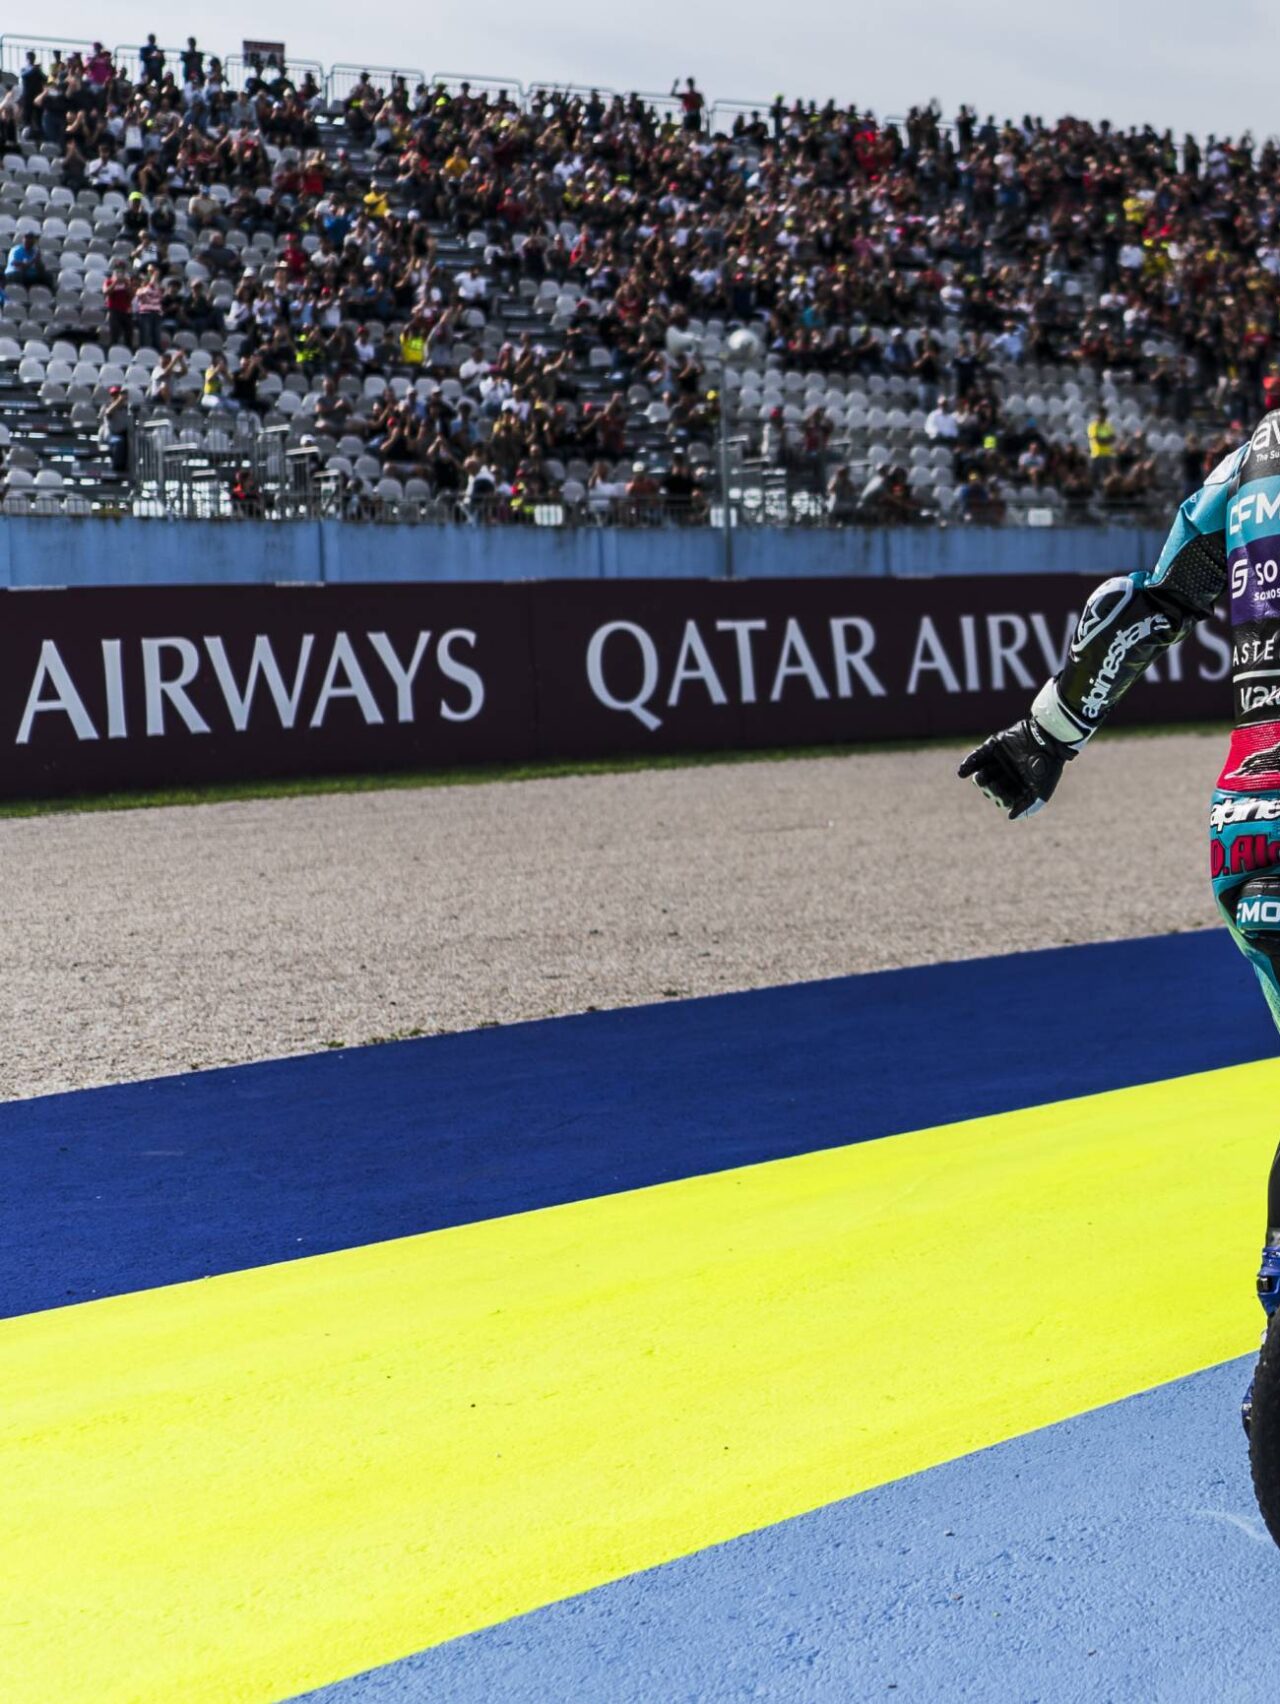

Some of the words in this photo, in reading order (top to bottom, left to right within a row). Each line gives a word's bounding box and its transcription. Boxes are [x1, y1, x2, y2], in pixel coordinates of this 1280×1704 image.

[1256, 453, 1269, 462] The
[15, 628, 485, 745] AIRWAYS
[585, 615, 887, 732] QATAR
[906, 606, 1231, 694] AIRS
